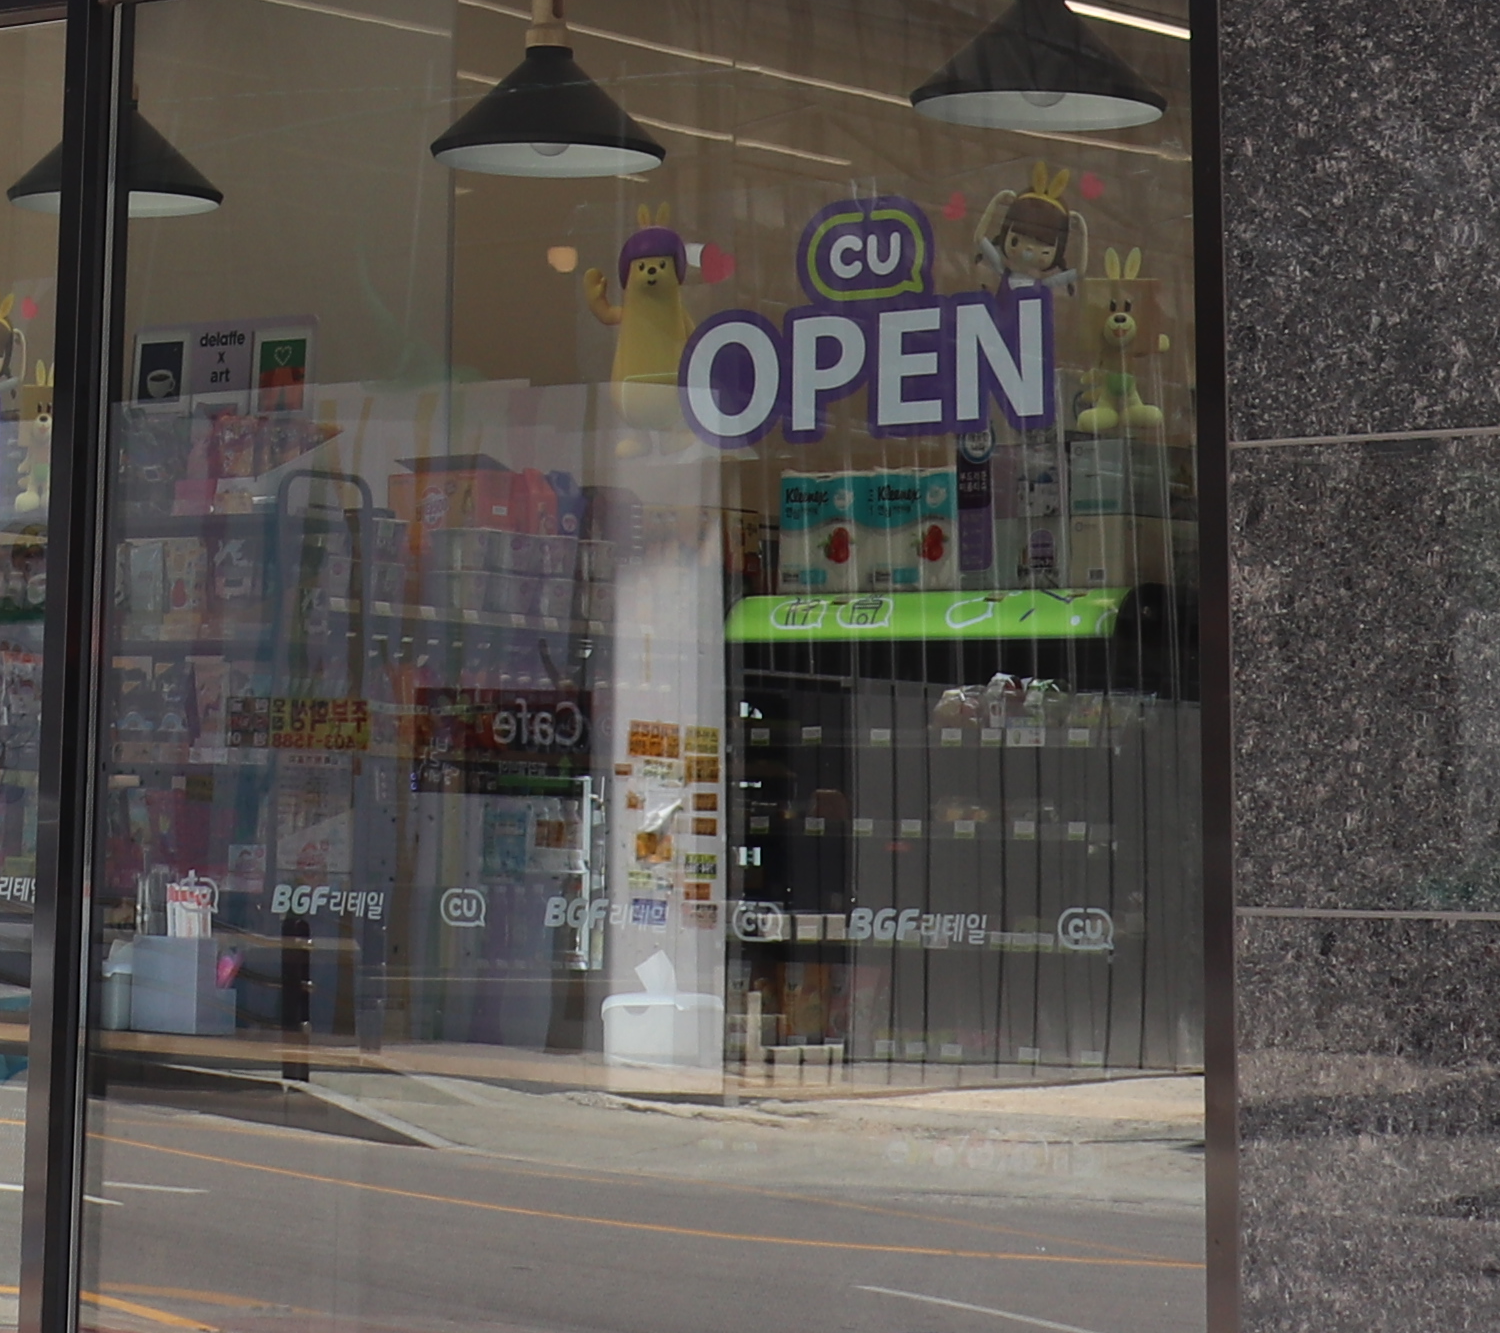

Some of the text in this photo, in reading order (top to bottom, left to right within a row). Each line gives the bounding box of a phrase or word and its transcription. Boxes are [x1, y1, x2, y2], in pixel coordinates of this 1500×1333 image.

[829, 232, 900, 279] CU
[209, 367, 231, 384] art
[686, 296, 1045, 437] OPEN
[271, 884, 386, 921] BGF리테일
[847, 906, 989, 945] BGF리테일
